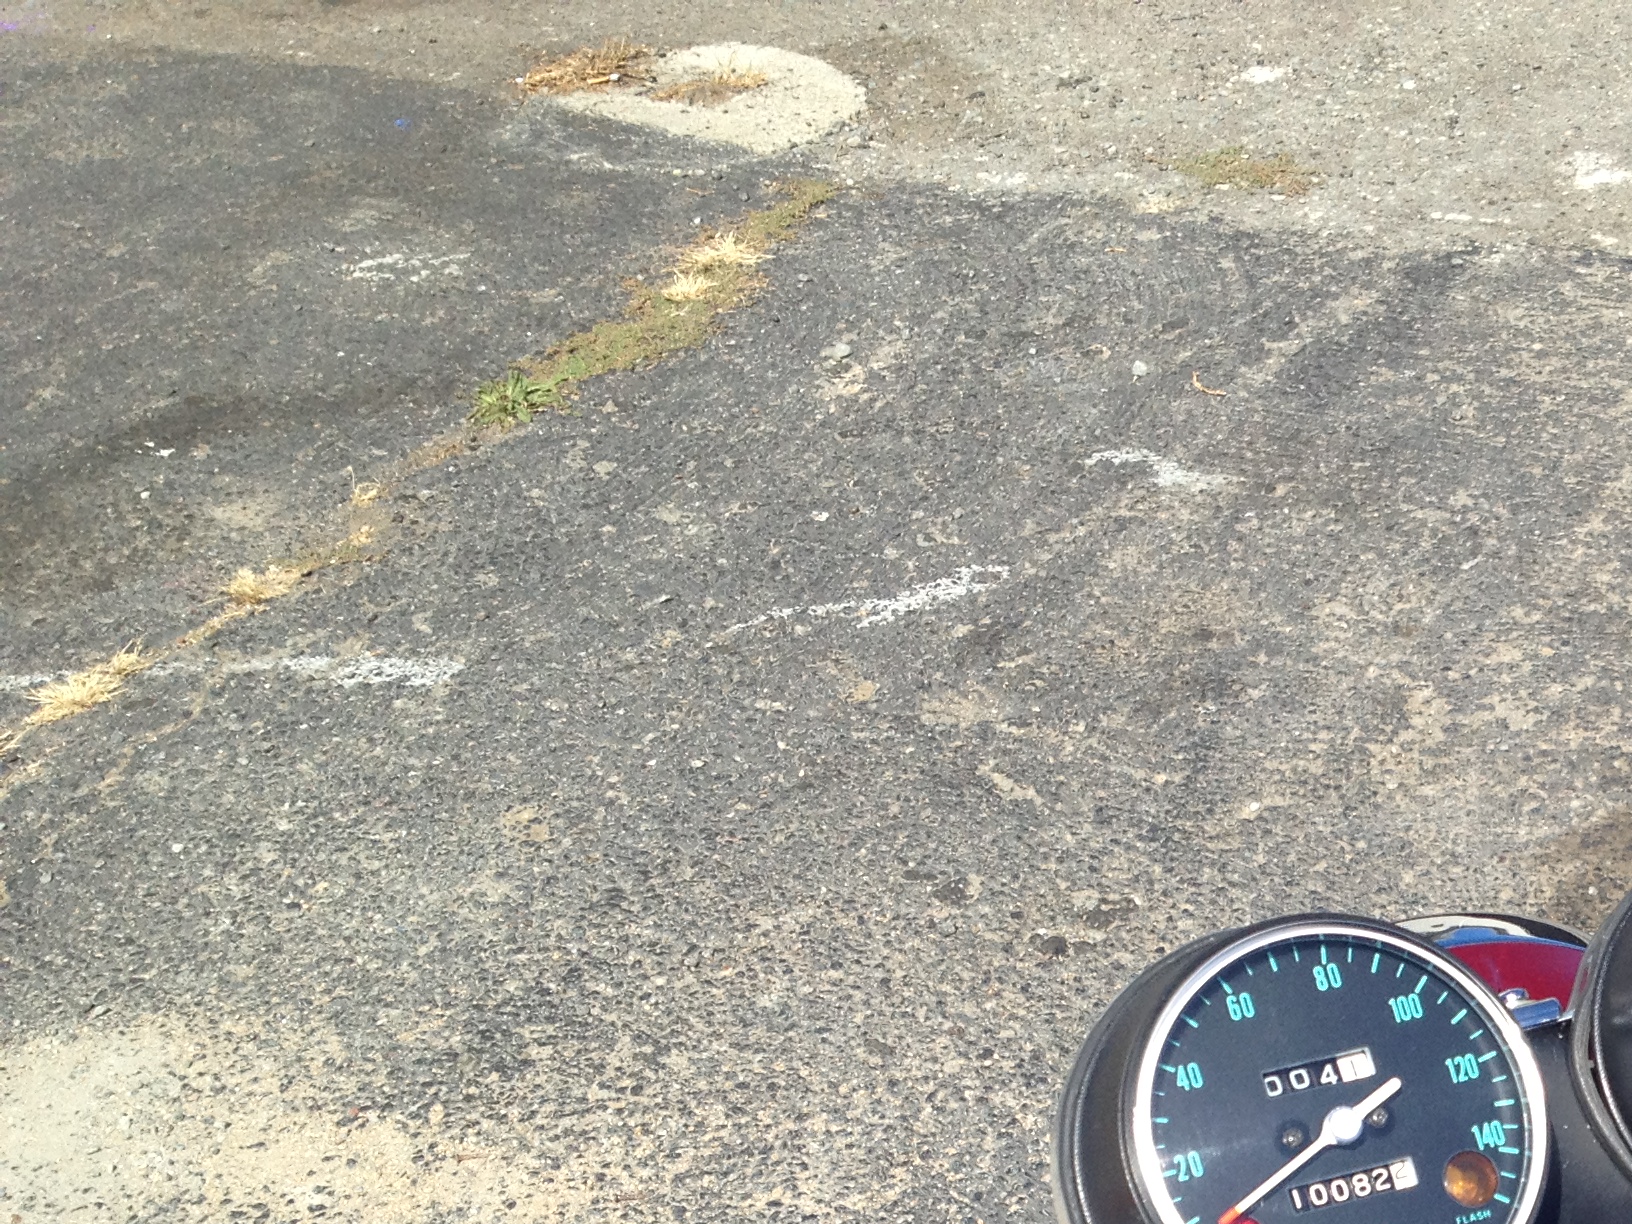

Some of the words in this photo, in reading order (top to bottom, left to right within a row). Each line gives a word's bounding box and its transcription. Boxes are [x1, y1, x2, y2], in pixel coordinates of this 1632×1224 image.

[1313, 961, 1343, 991] 80
[1226, 992, 1256, 1022] 60
[1388, 992, 1424, 1023] 100
[1176, 1061, 1204, 1091] 40
[1445, 1053, 1480, 1084] 120
[1471, 1120, 1505, 1151] 140
[1175, 1151, 1205, 1182] 20
